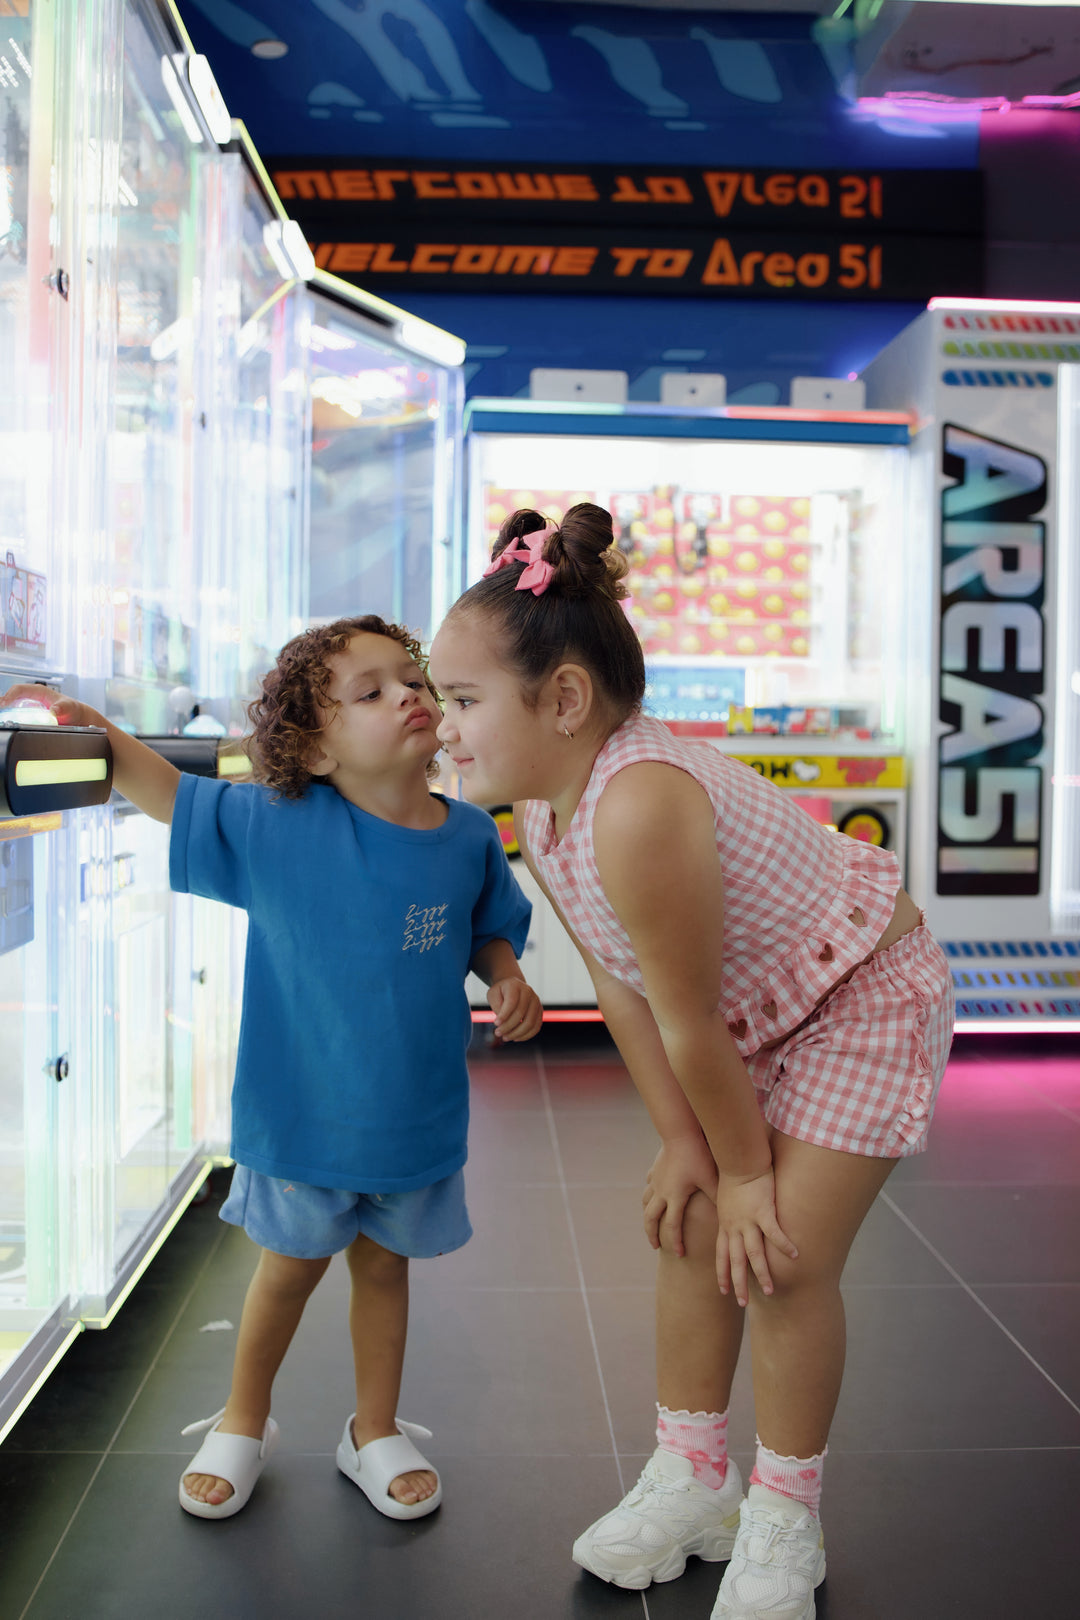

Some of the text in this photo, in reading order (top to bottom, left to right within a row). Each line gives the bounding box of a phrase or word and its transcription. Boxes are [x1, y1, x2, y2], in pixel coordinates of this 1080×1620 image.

[610, 248, 693, 277] TO
[701, 238, 830, 288] Area
[838, 245, 883, 289] 51
